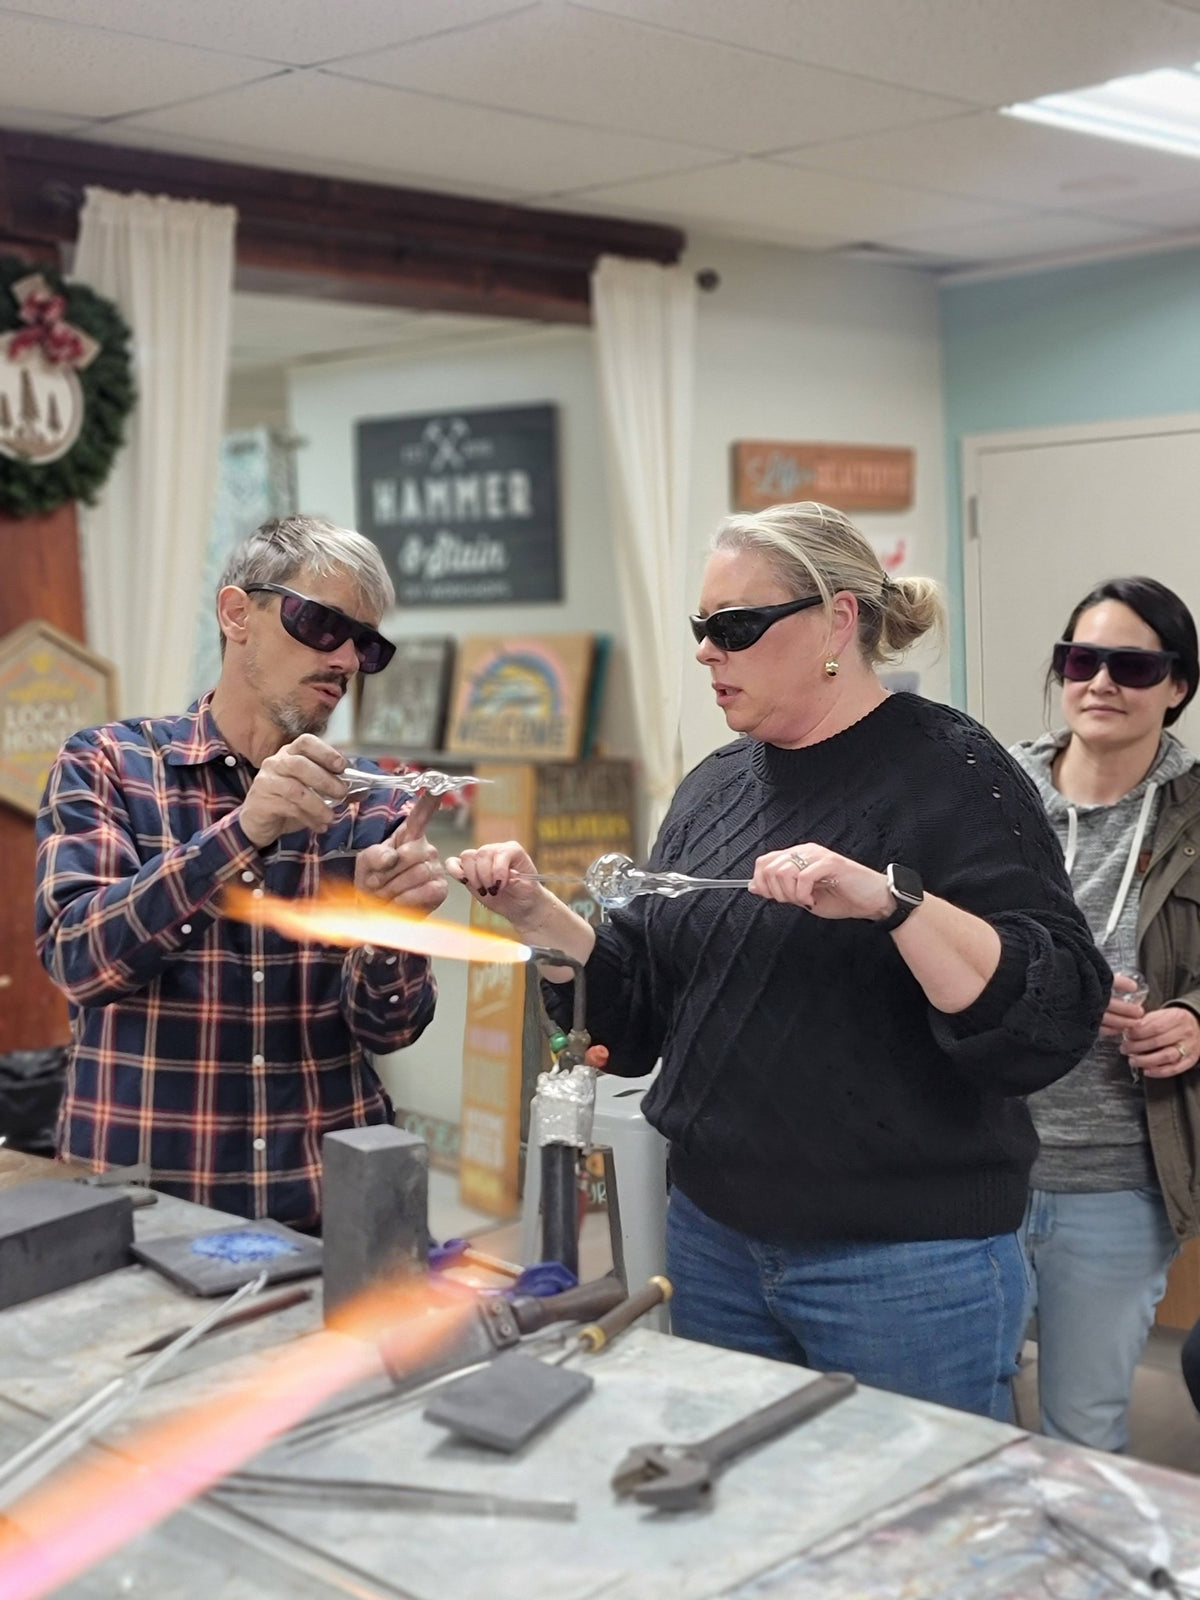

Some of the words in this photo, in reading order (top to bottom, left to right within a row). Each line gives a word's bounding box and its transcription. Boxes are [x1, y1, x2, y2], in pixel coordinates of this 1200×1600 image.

[373, 470, 533, 525] HAMMER
[422, 530, 507, 580] Stain
[5, 702, 84, 728] LOCAL
